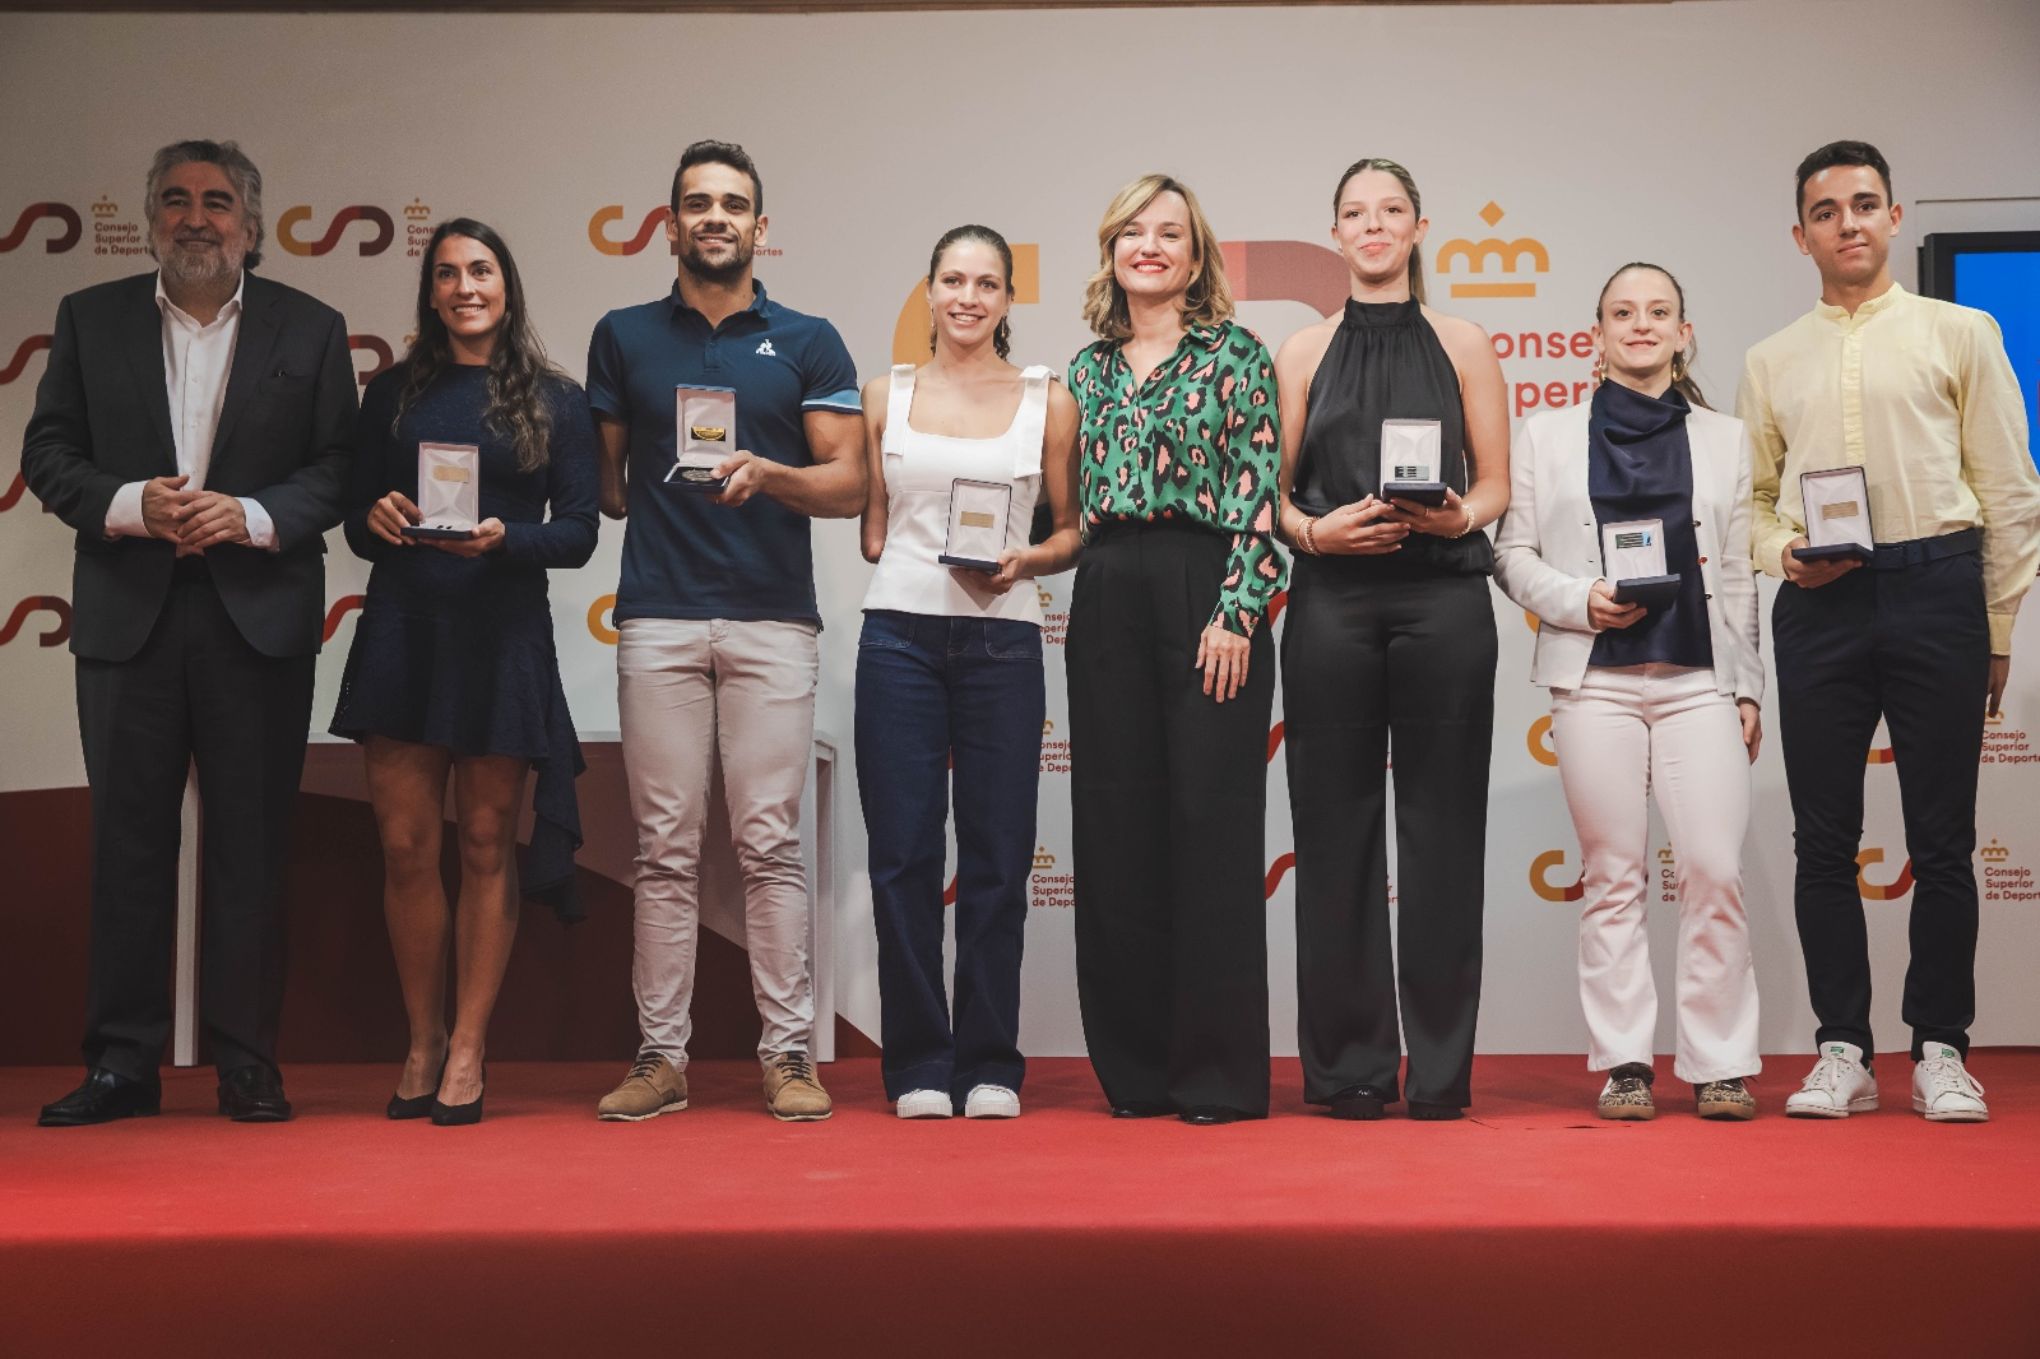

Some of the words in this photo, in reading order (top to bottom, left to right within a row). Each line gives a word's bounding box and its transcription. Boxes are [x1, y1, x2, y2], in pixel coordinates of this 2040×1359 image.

[94, 222, 138, 234] Consejo
[407, 224, 436, 235] Cons
[95, 233, 141, 245] Superior
[407, 236, 428, 247] Sup
[94, 245, 108, 256] de
[111, 245, 149, 257] Deport
[407, 247, 420, 257] de
[1490, 332, 1600, 361] onse
[1983, 729, 2026, 742] Consejo
[1982, 741, 2030, 753] Superior
[1040, 752, 1072, 763] uperio
[1981, 753, 1995, 763] de
[1984, 866, 2031, 880] Consejo
[1986, 878, 2035, 890] Superior
[1032, 885, 1074, 897] Superio
[1662, 892, 1676, 902] de
[1985, 890, 2000, 900] de
[1032, 897, 1046, 907] de
[1048, 897, 1076, 909] Depo
